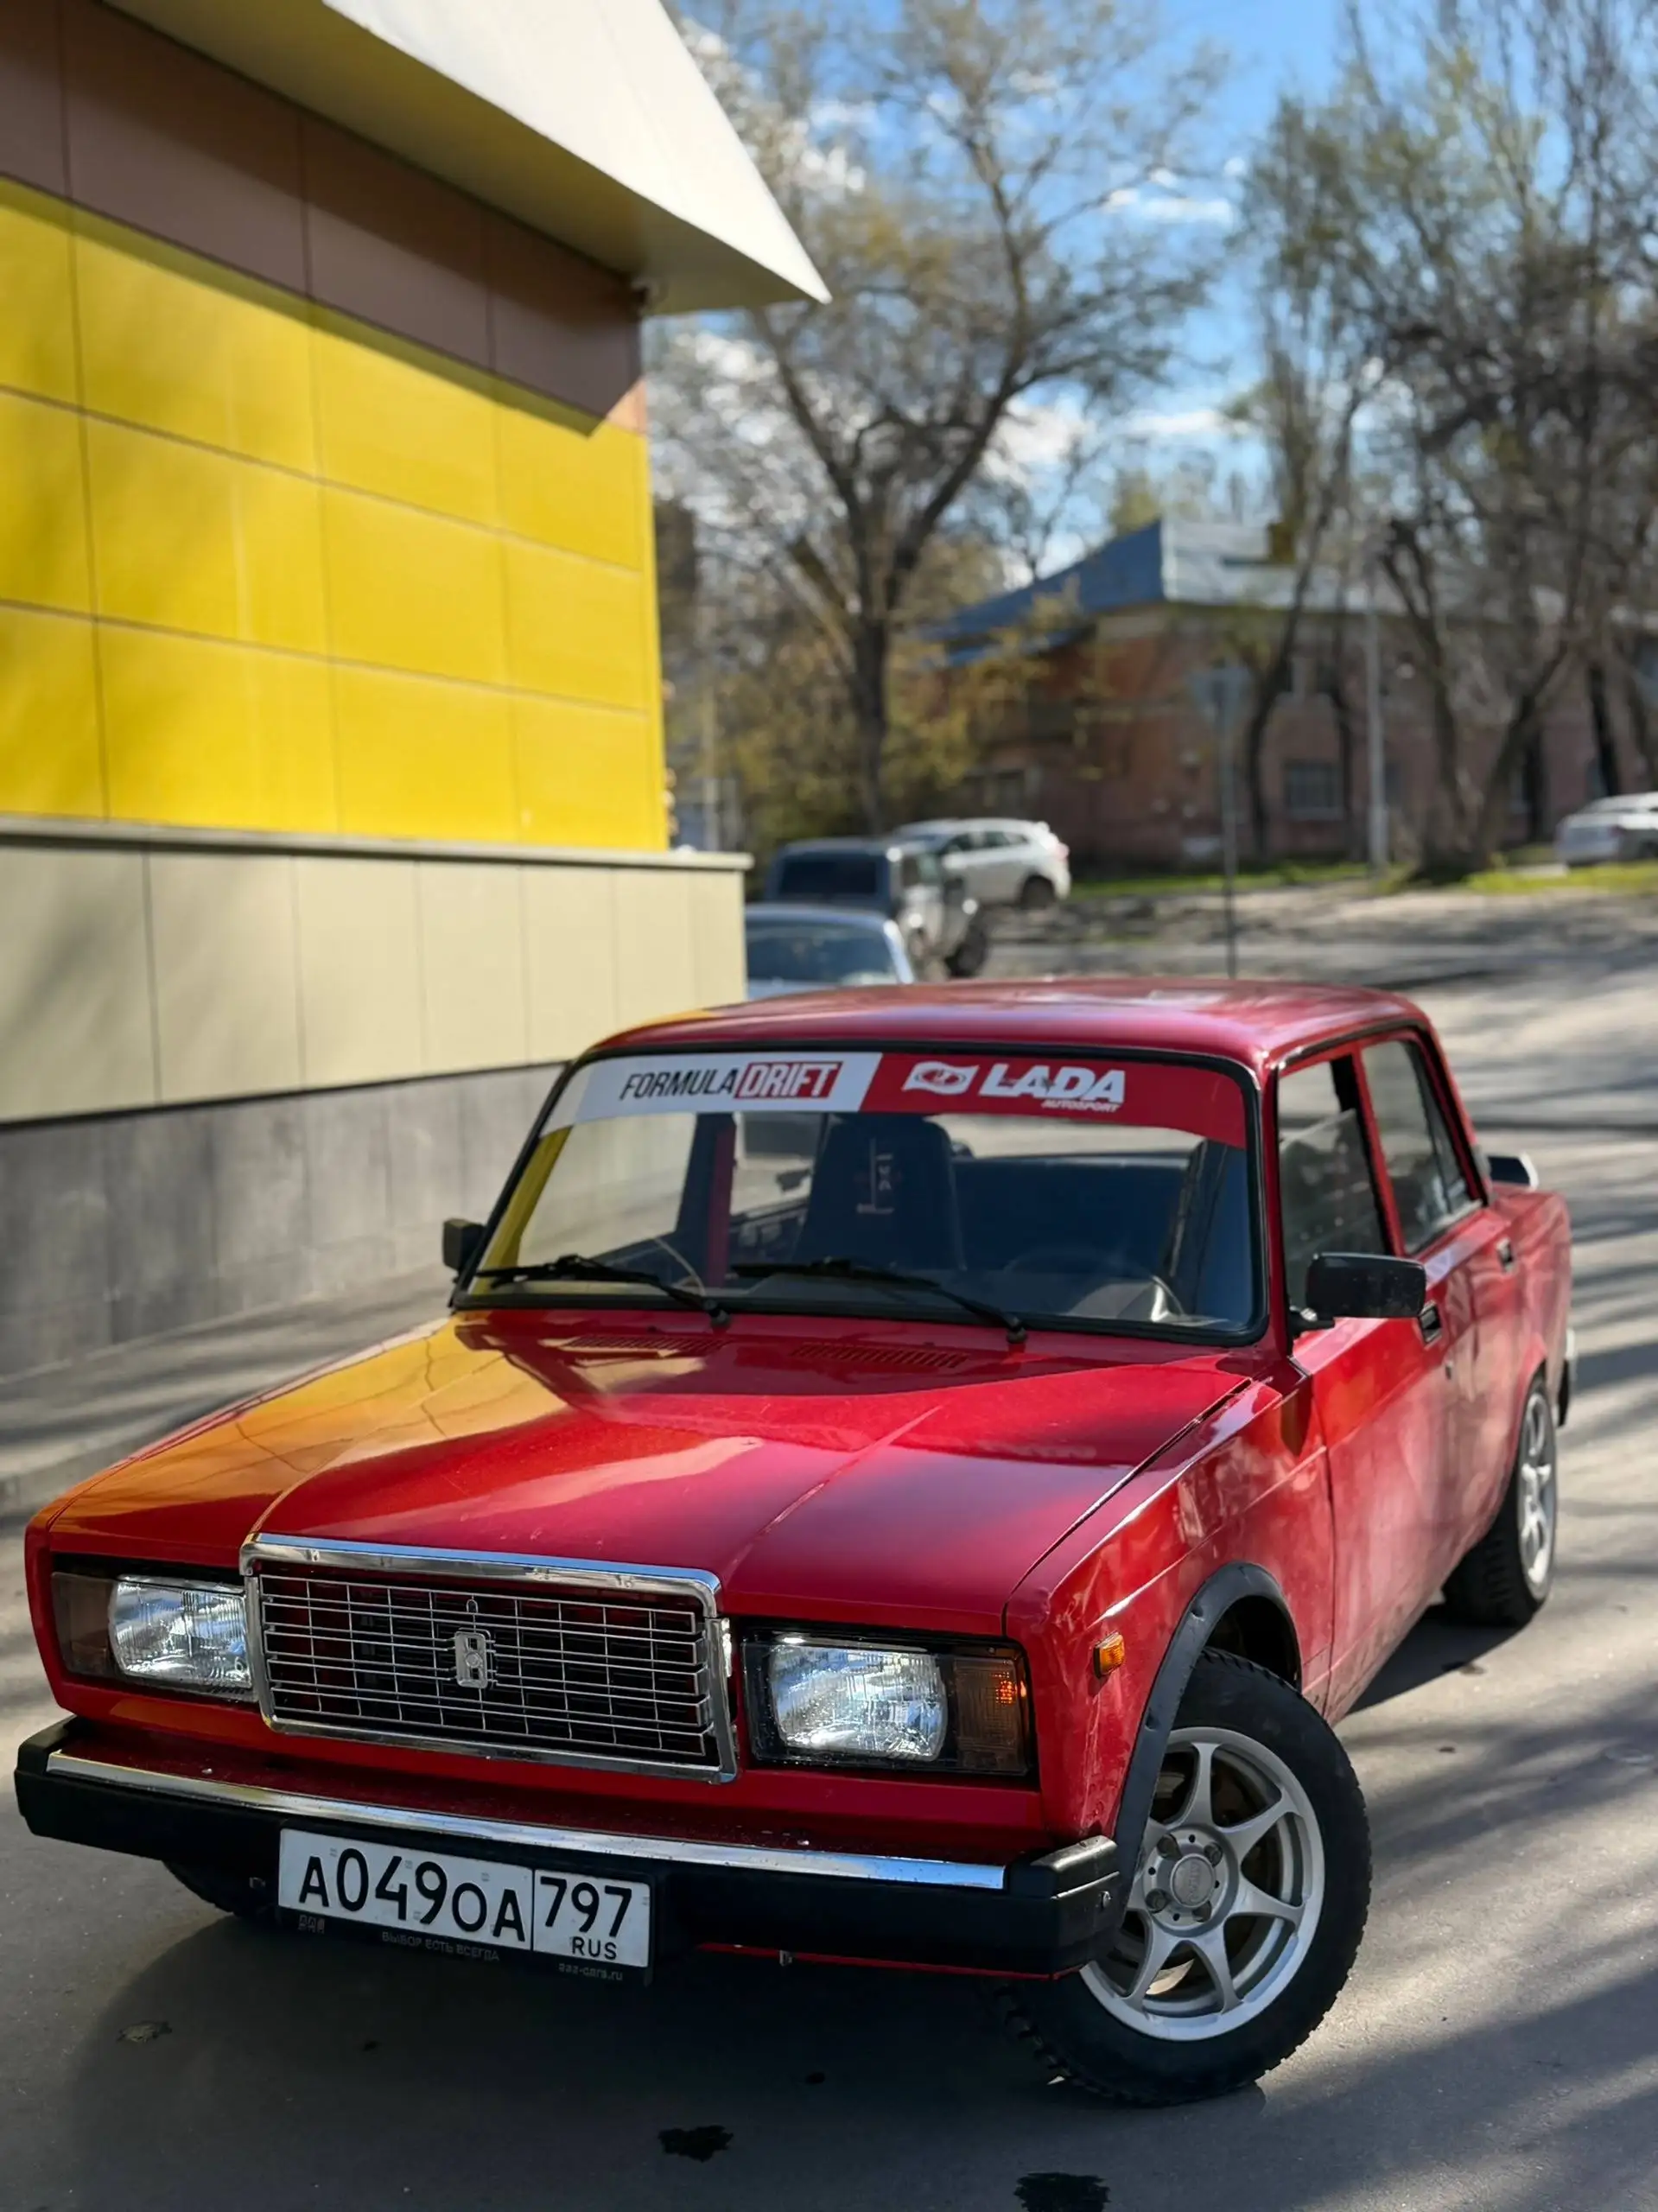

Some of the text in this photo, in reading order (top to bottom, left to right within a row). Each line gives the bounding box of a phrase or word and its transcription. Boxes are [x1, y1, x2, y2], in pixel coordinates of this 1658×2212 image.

[619, 1063, 840, 1101] FORMULA DRIFT
[978, 1064, 1126, 1103] LADA
[539, 1876, 632, 1937] 797
[571, 1936, 618, 1961] RUS
